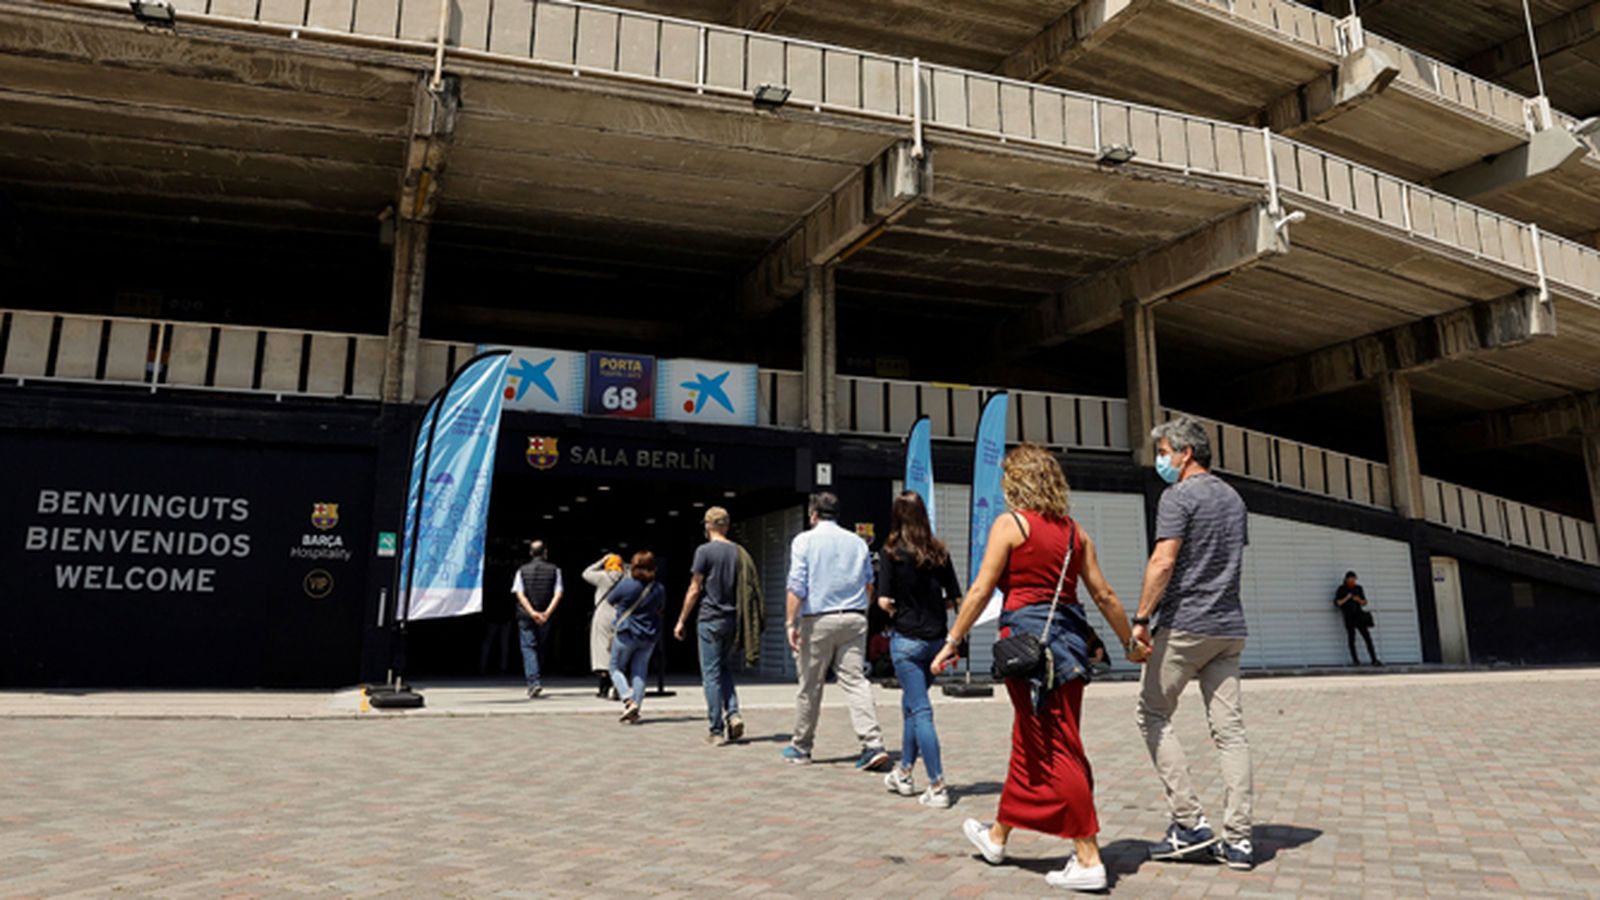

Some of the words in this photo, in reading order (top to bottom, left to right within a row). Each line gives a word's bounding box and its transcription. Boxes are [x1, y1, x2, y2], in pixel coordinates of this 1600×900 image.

[599, 357, 642, 372] PORTA
[602, 386, 638, 411] 68
[569, 445, 629, 467] SALA
[635, 447, 715, 471] BERLÍN
[37, 490, 250, 521] BENVINGUTS
[25, 526, 252, 558] BIENVENIDOS
[301, 533, 344, 548] BARÇA
[289, 546, 353, 562] Hospitality
[55, 565, 216, 593] WELCOME
